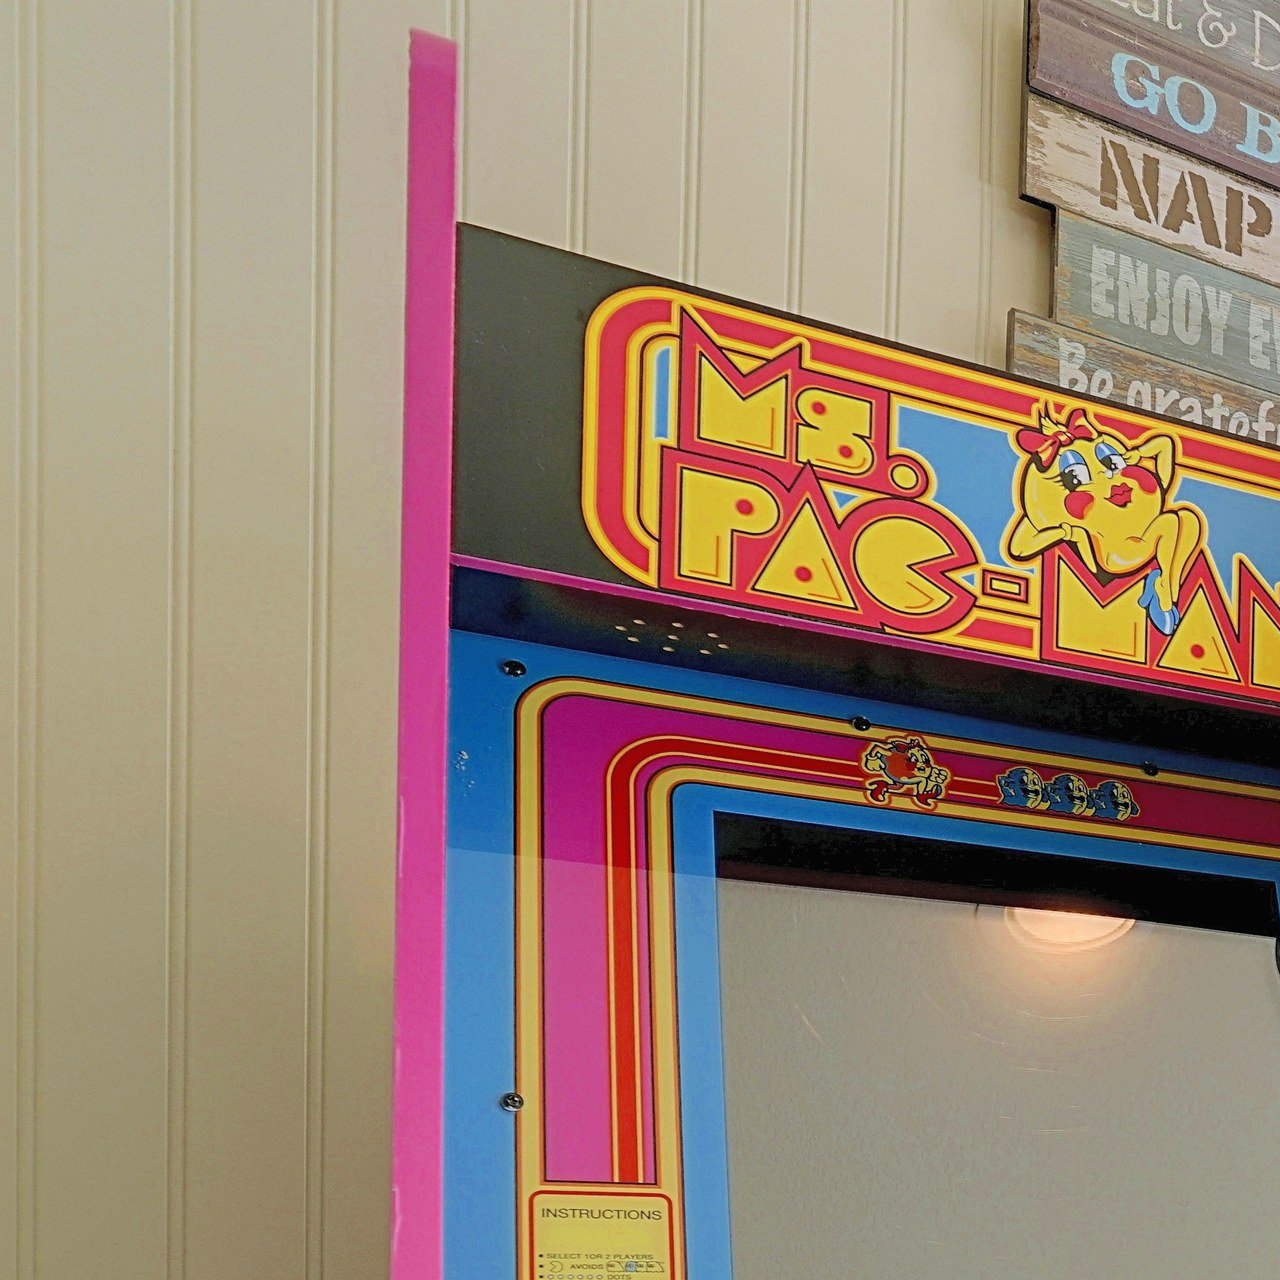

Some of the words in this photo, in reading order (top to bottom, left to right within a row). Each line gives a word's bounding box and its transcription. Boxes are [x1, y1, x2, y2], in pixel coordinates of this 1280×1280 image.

[1112, 0, 1182, 30] at
[1197, 0, 1237, 48] &
[1111, 52, 1218, 134] GO
[1100, 136, 1273, 257] NAP
[1090, 244, 1235, 355] ENJOY
[541, 1207, 663, 1221] INSTRUCTIONS
